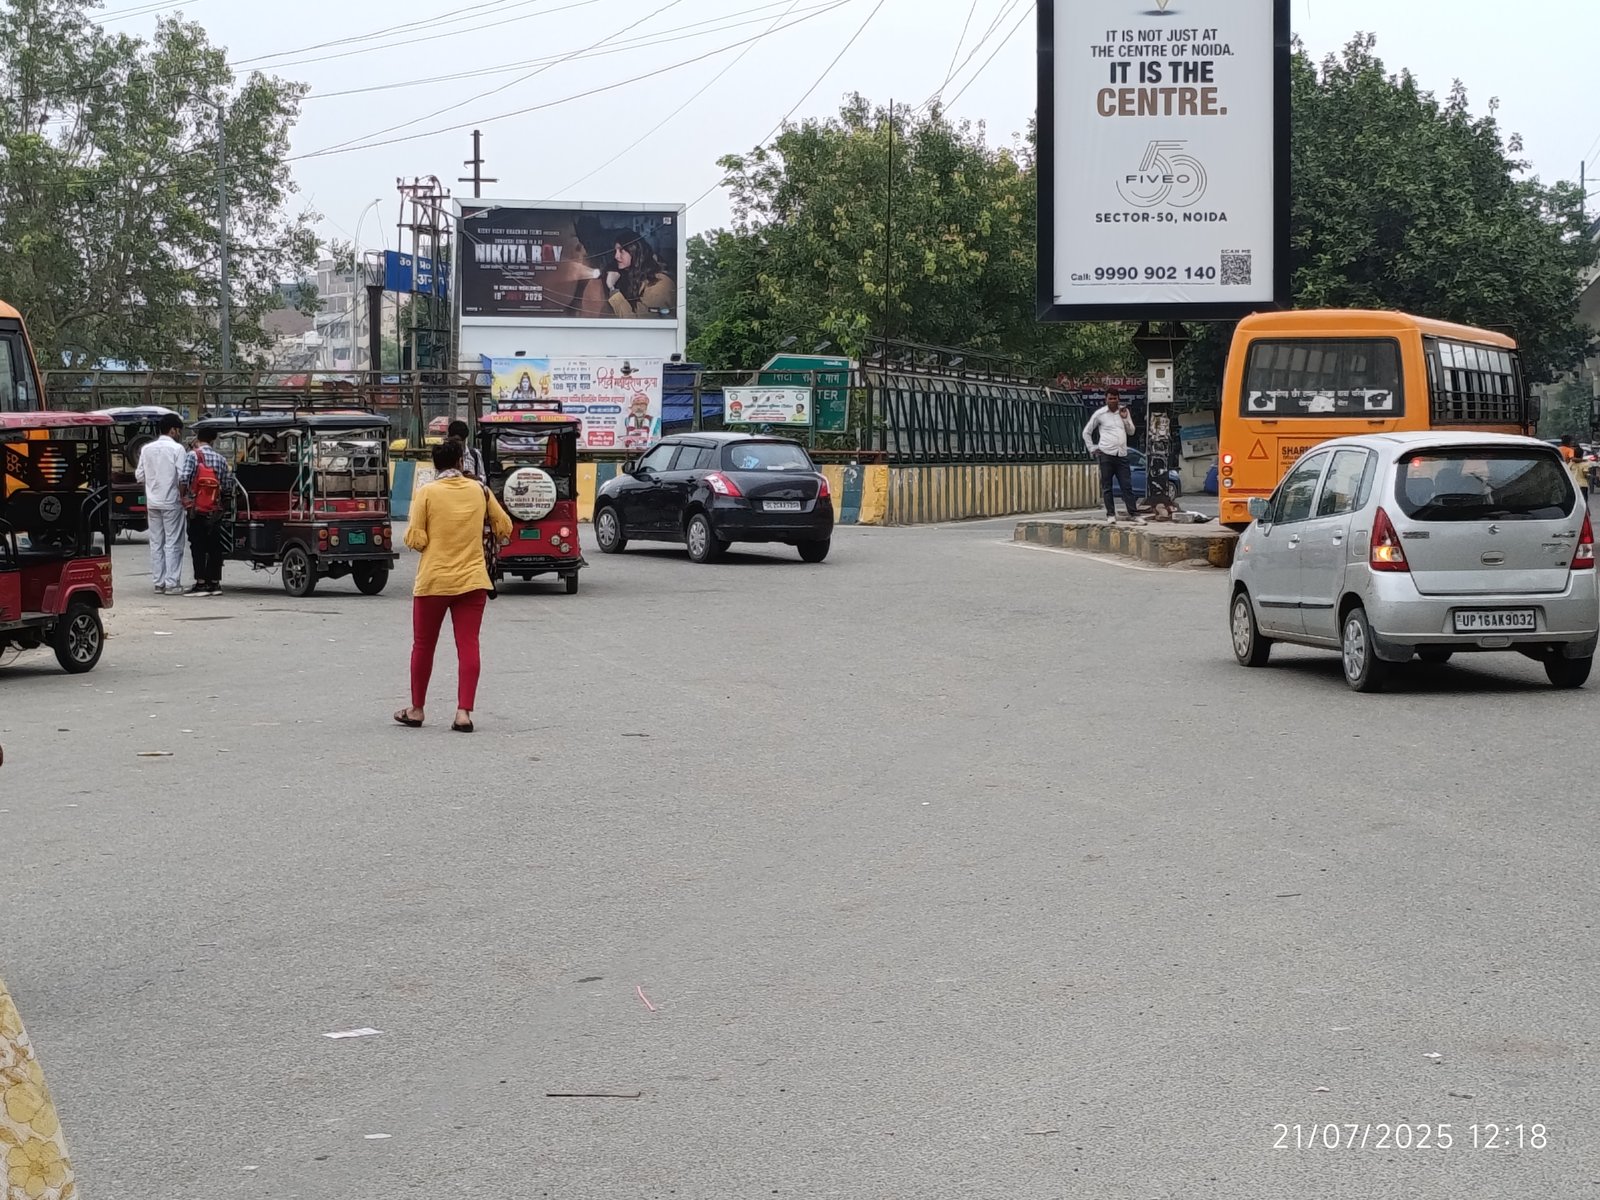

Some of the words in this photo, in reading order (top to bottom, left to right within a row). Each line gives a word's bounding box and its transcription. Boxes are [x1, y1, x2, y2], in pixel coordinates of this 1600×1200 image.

[1106, 30, 1117, 42] IT
[1122, 30, 1134, 42] IS
[1138, 30, 1163, 42] NOT
[1166, 29, 1198, 42] JUST
[1202, 29, 1218, 41] AT
[1091, 45, 1114, 58] THE
[1118, 45, 1167, 57] CENTRE
[1171, 44, 1188, 57] OF
[1191, 44, 1235, 56] NOIDA.
[1110, 62, 1131, 84] IT
[1139, 61, 1162, 84] IS
[1168, 61, 1214, 83] THE
[1097, 87, 1228, 117] CENTRE.
[1095, 213, 1178, 224] SECTOR-50,
[1182, 212, 1228, 222] NOIDA
[475, 244, 527, 263] NIKITA
[532, 244, 562, 263] ROY
[1071, 272, 1092, 282] Call:
[1094, 267, 1138, 281] 9990
[1144, 266, 1178, 280] 902
[1184, 266, 1217, 280] 140
[1462, 614, 1534, 627] UP16AK9032
